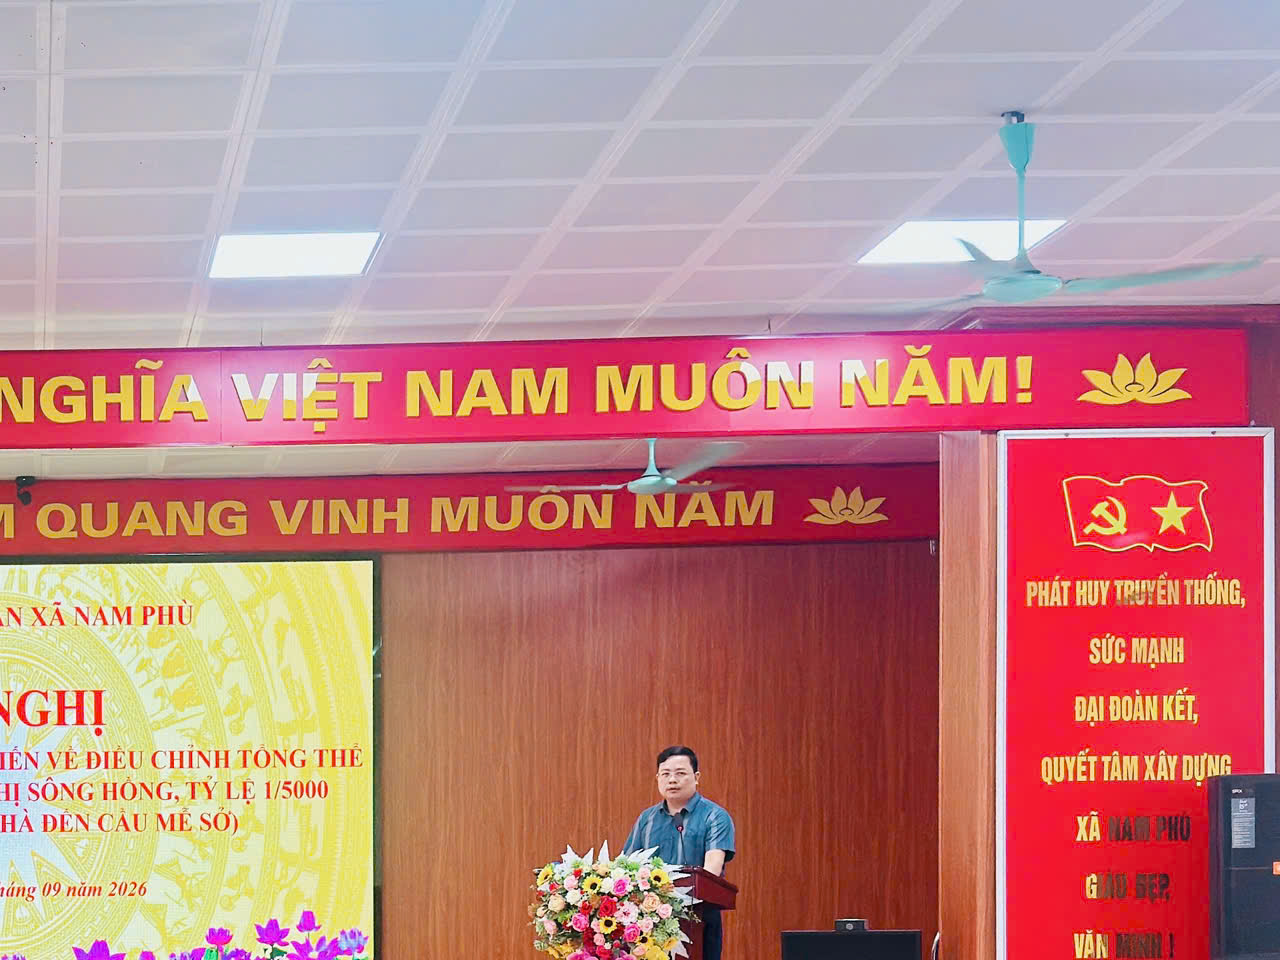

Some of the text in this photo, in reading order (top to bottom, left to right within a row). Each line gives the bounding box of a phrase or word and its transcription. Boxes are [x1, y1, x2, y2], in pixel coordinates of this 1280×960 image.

[230, 359, 383, 432] VIỆT
[405, 367, 568, 416] NAM
[593, 347, 814, 412] MUÔN
[839, 341, 1035, 408] NĂM!
[36, 501, 248, 540] QUANG
[270, 498, 409, 536] VINH
[430, 484, 614, 533] MUÔN
[634, 480, 776, 529] NĂM
[1026, 571, 1246, 608] PHÁT HUY TRUYỀN THỐNG,
[31, 602, 71, 627] XÃ
[74, 606, 133, 626] NAM
[142, 601, 194, 626] PHÙ
[1089, 634, 1184, 669] SỨC MẠNH
[1074, 688, 1198, 726] ĐẠI ĐOÀN KẾT,
[47, 746, 78, 769] VỀ
[86, 746, 143, 769] ĐIỀU
[151, 744, 230, 769] CHỈNH
[237, 743, 306, 769] TỔNG
[313, 742, 363, 768] THỂ
[1041, 748, 1232, 786] QUYẾT TÂM XÂY DỰNG
[27, 777, 93, 802] SÔNG
[102, 778, 180, 805] HỒNG,
[185, 776, 218, 801] TỶ
[226, 777, 256, 805] LỆ
[264, 780, 329, 801] 1/5000
[0, 812, 34, 834] HÀ
[42, 809, 90, 834] ĐẾN
[97, 809, 148, 833] CẦU
[199, 806, 239, 835] SỞ)
[1076, 811, 1101, 842] XÃ
[1108, 816, 1150, 841] NAM
[42, 881, 61, 897] 09
[67, 883, 103, 897] năm
[108, 881, 147, 897] 2026
[1074, 930, 1109, 959] VĂN
[1116, 933, 1162, 959] MINH
